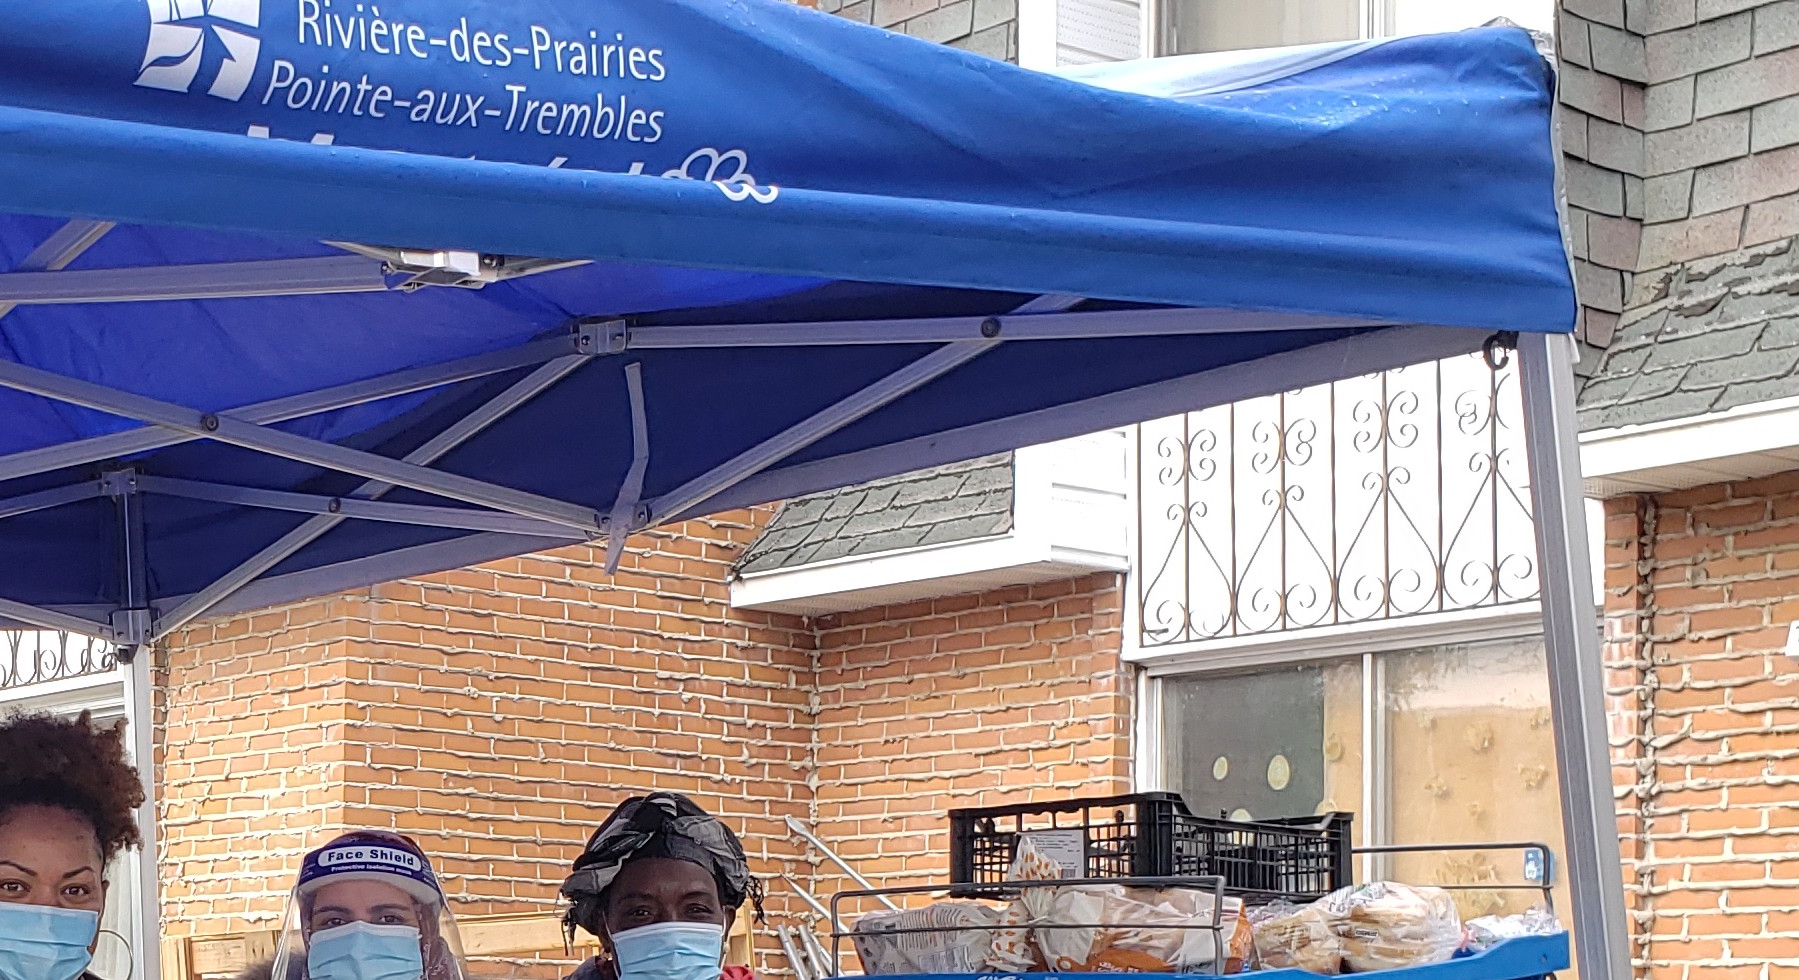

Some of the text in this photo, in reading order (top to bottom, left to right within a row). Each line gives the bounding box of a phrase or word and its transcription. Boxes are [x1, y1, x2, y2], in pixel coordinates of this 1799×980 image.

[297, 0, 667, 82] Rivière-des-Prairies
[261, 60, 665, 144] Pointe-aux-Trembles
[327, 849, 415, 866] Face Shield
